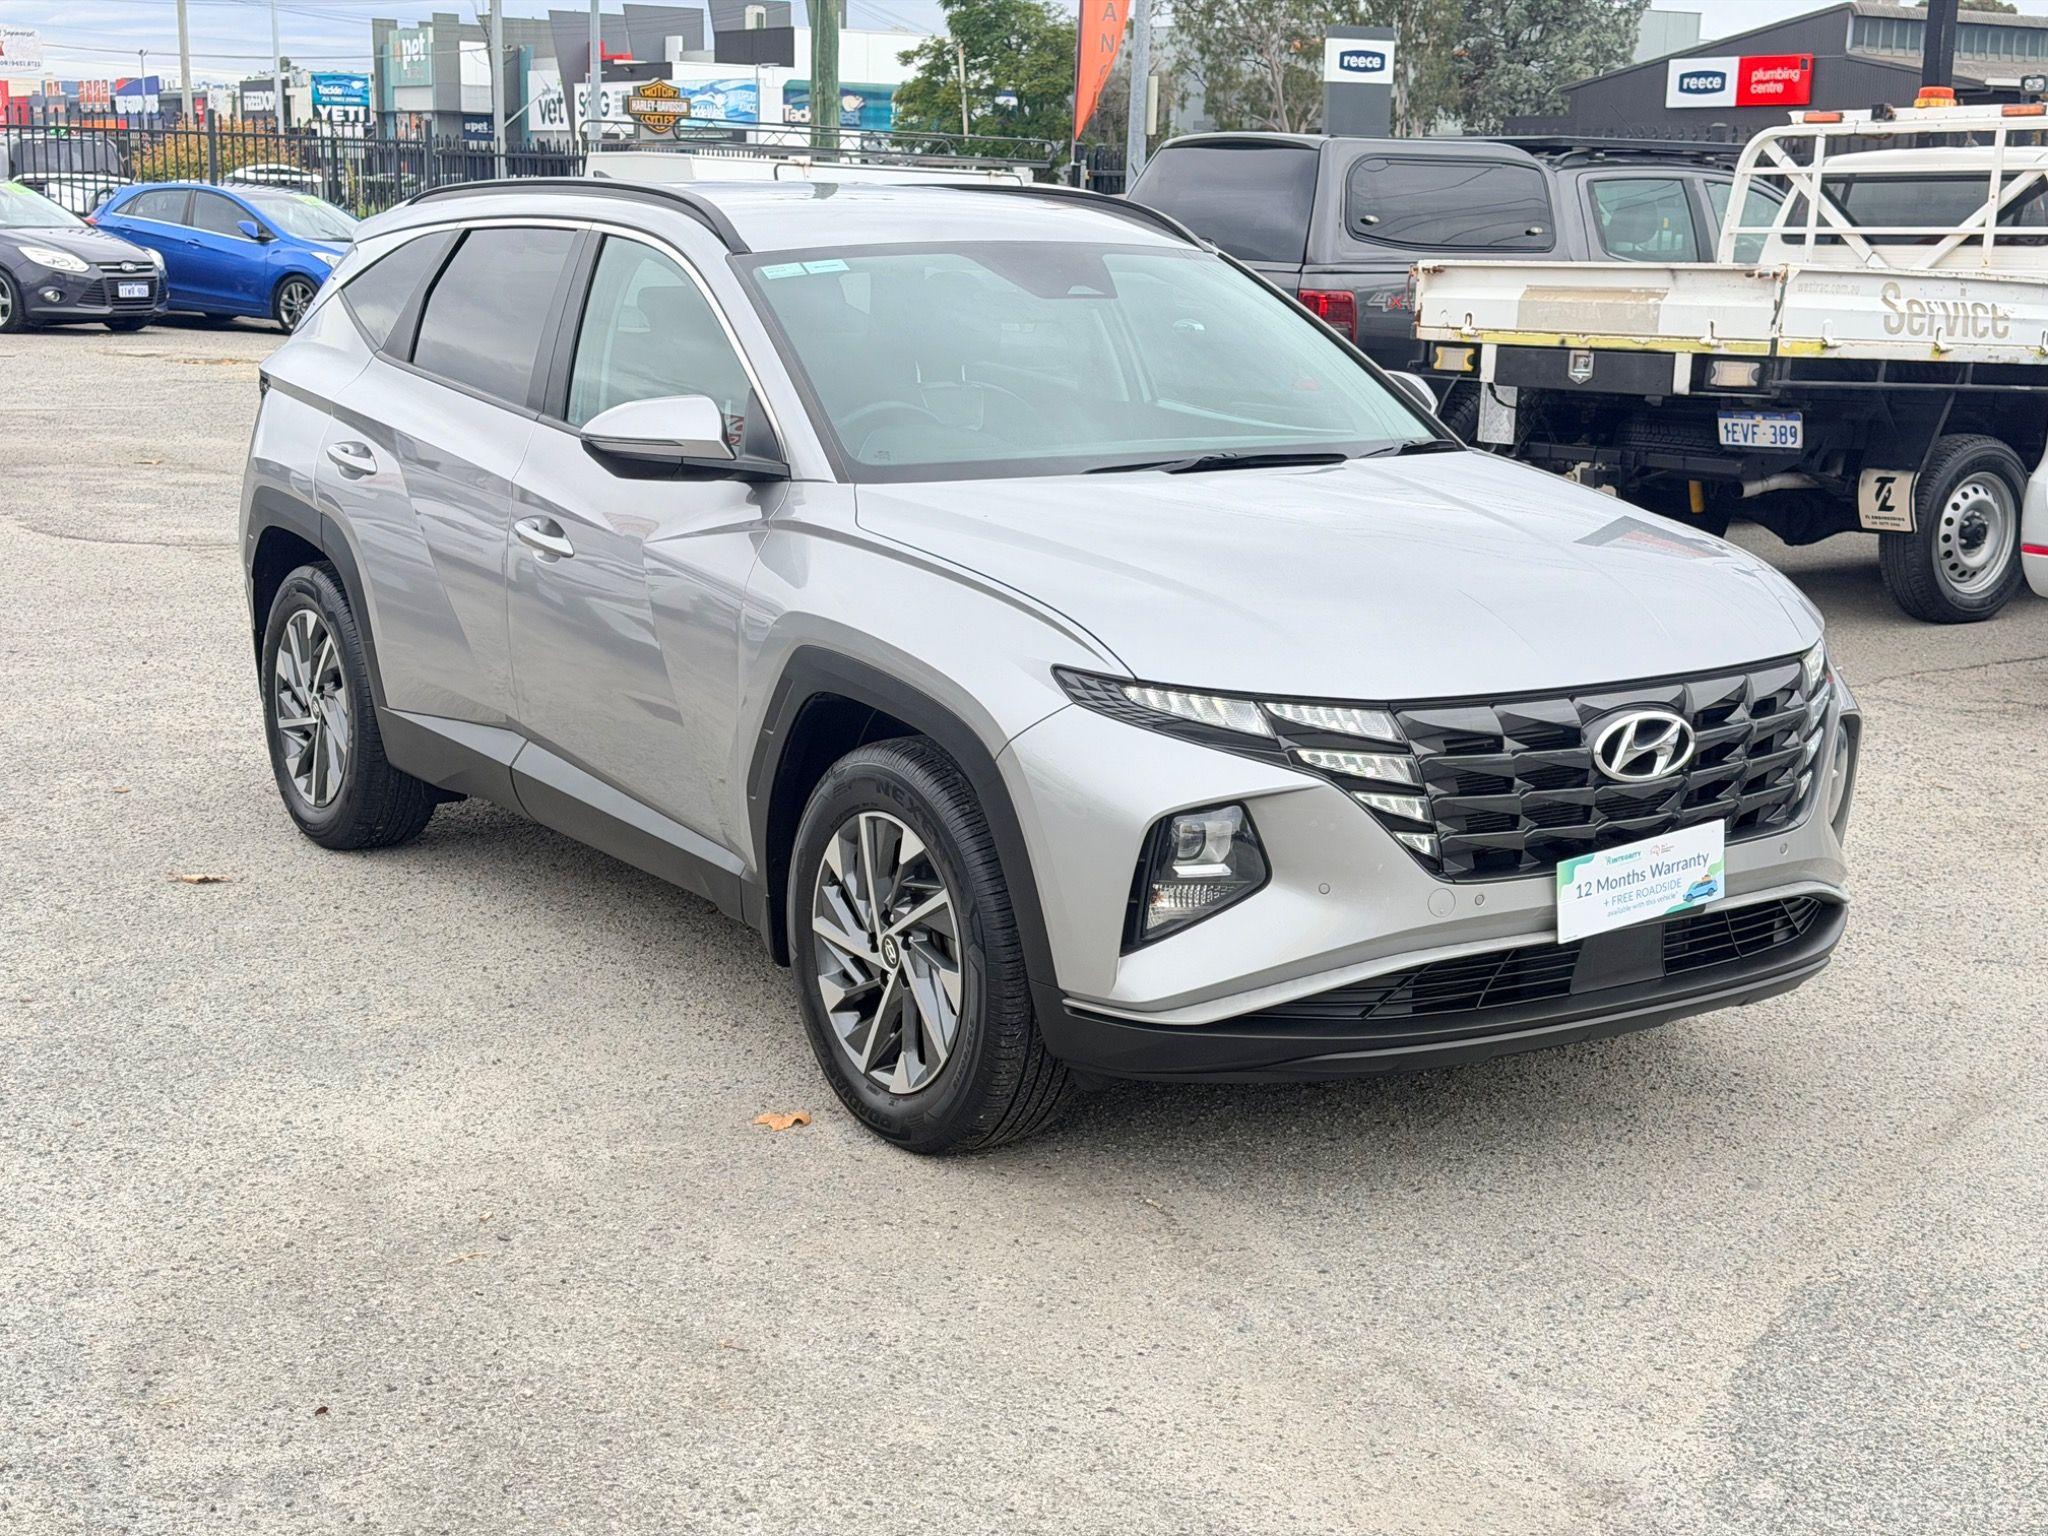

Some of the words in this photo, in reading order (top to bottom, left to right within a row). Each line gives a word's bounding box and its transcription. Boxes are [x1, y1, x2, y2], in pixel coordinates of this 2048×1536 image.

[1343, 55, 1381, 68] reece
[1751, 67, 1800, 83] plumbing
[1682, 76, 1722, 89] reece
[1750, 82, 1784, 94] centre
[644, 88, 675, 98] MOTOR
[316, 105, 367, 122] YETI
[538, 91, 564, 124] vet
[644, 114, 676, 124] CYCLES
[1881, 281, 2011, 339] Service
[1576, 881, 1592, 899] 12
[1596, 869, 1646, 894] Months
[1650, 853, 1710, 879] Warranty
[1612, 891, 1634, 906] FREE
[1636, 878, 1682, 900] ROADSIDE
[1633, 901, 1645, 912] with
